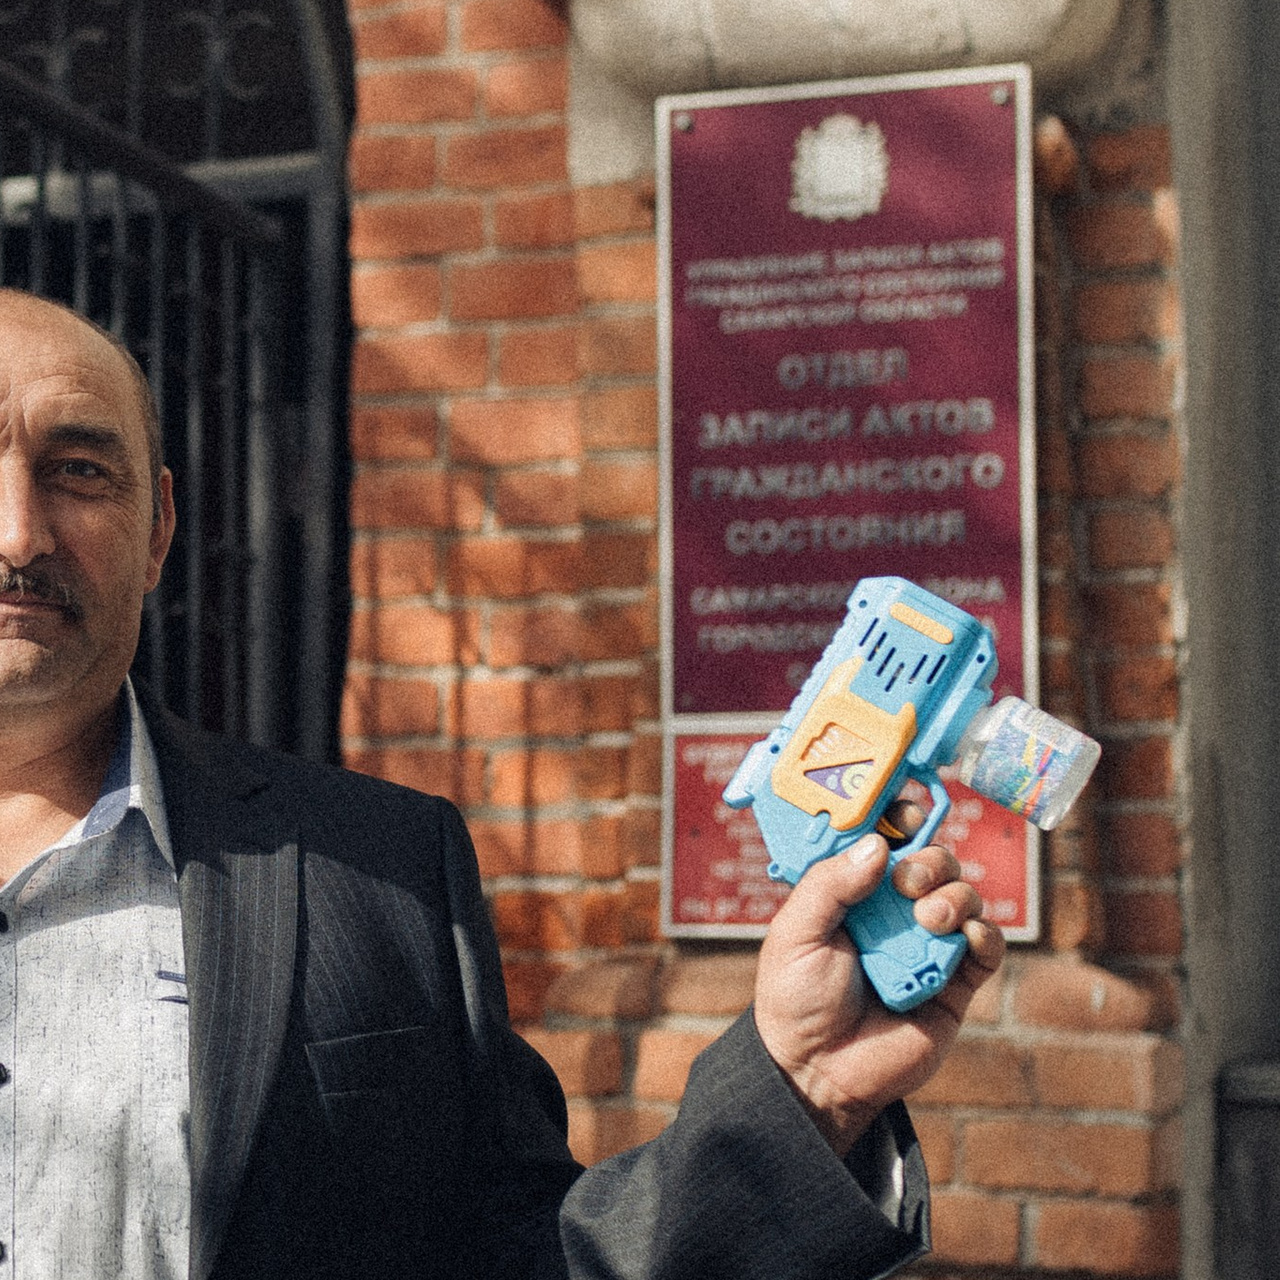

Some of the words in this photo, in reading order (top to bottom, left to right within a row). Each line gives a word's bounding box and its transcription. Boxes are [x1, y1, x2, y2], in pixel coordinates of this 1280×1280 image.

[778, 348, 908, 390] ОТДЕЛ
[699, 408, 852, 449] ЗАПИСИ
[863, 398, 995, 437] АКТОВ
[691, 452, 1004, 500] ГРАЖДАНСКОГО
[725, 509, 966, 555] СОСТОЯНИЯ
